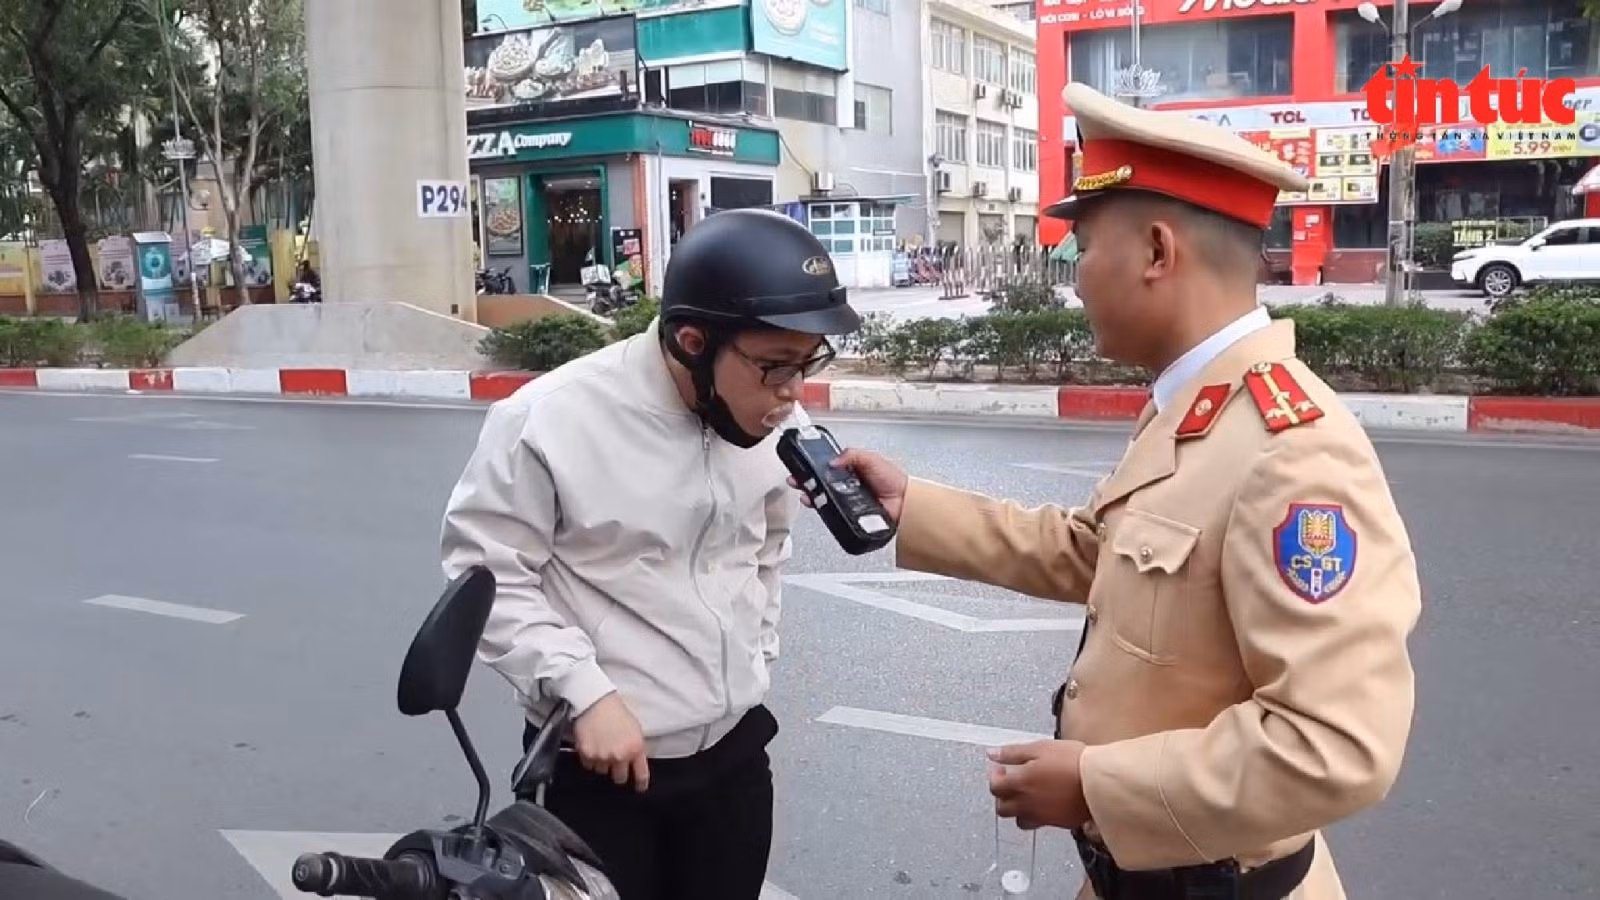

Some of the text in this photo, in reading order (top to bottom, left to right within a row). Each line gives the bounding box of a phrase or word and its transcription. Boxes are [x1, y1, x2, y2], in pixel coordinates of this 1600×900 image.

[1270, 110, 1307, 124] TCL
[1351, 107, 1372, 122] TC
[514, 132, 573, 148] Company
[1513, 140, 1551, 155] 5.99
[1291, 554, 1343, 573] CS GT
